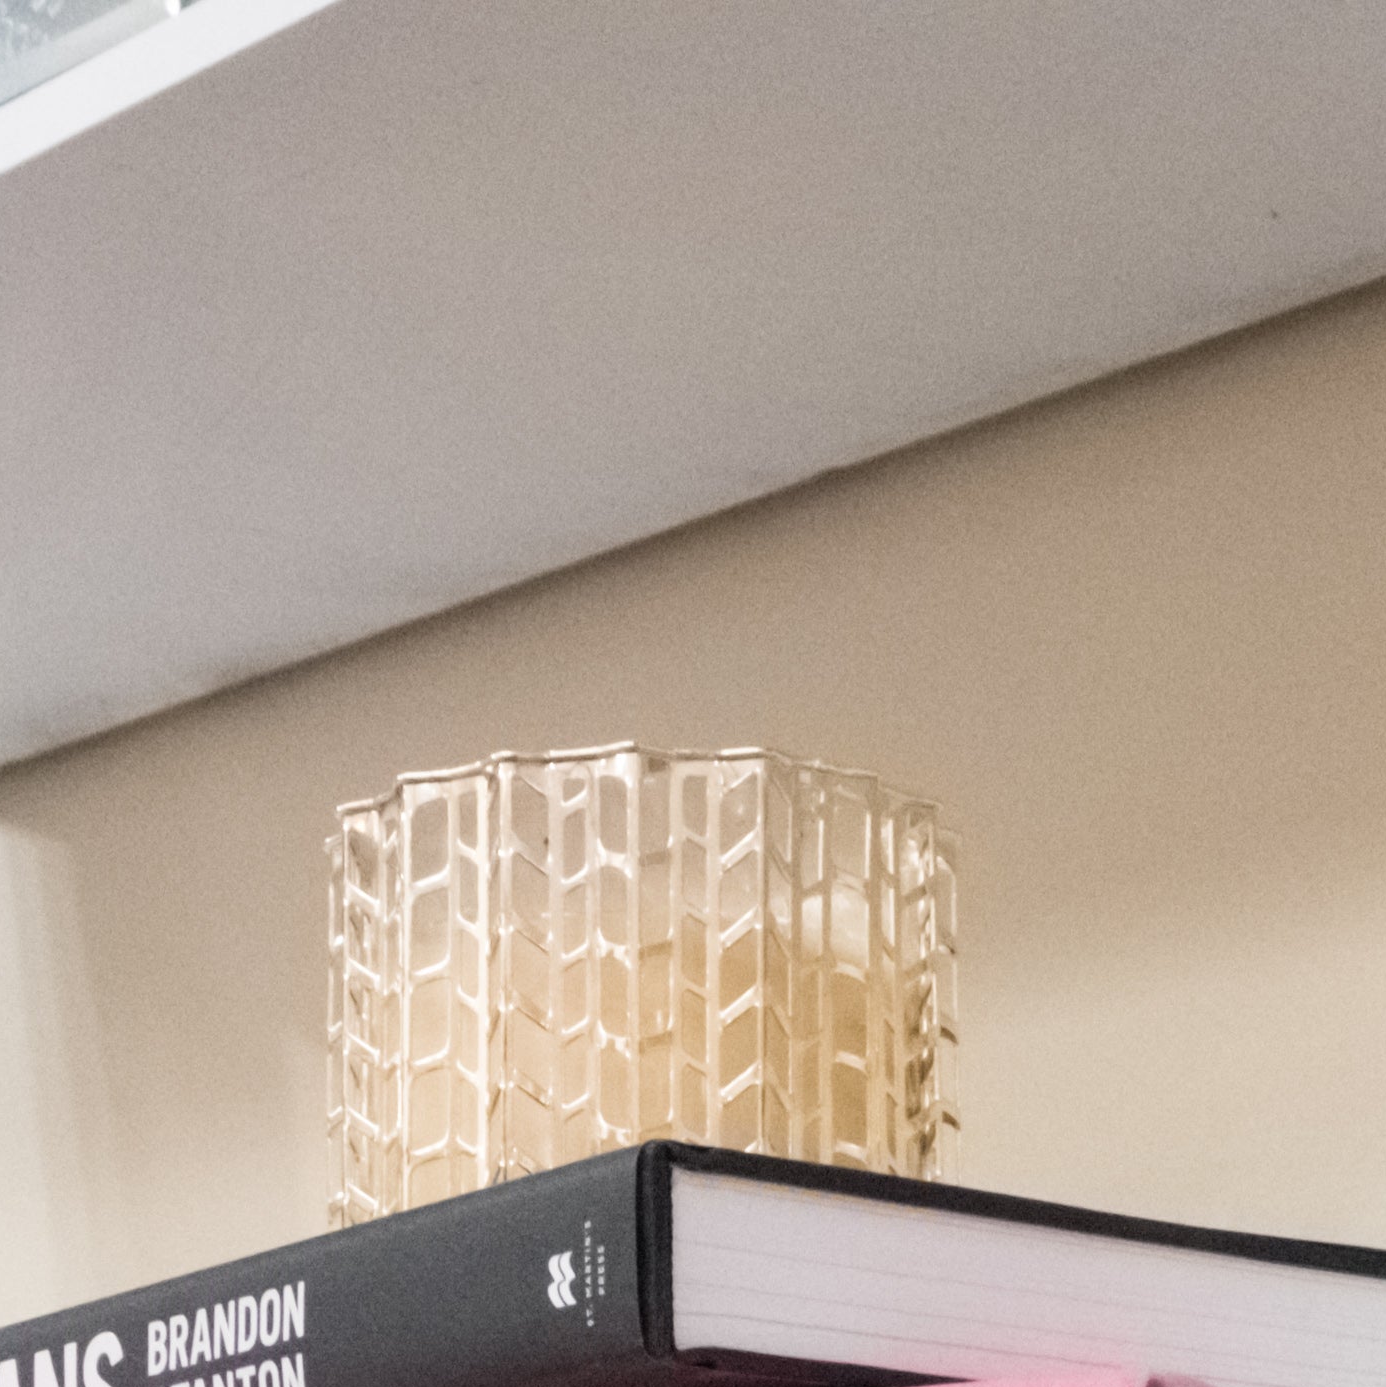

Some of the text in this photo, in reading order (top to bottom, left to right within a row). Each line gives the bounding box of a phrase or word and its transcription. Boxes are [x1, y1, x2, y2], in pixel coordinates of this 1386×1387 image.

[583, 1219, 592, 1299] MARTIN'S
[596, 1244, 606, 1297] PRESS
[146, 1281, 306, 1377] BRANDON
